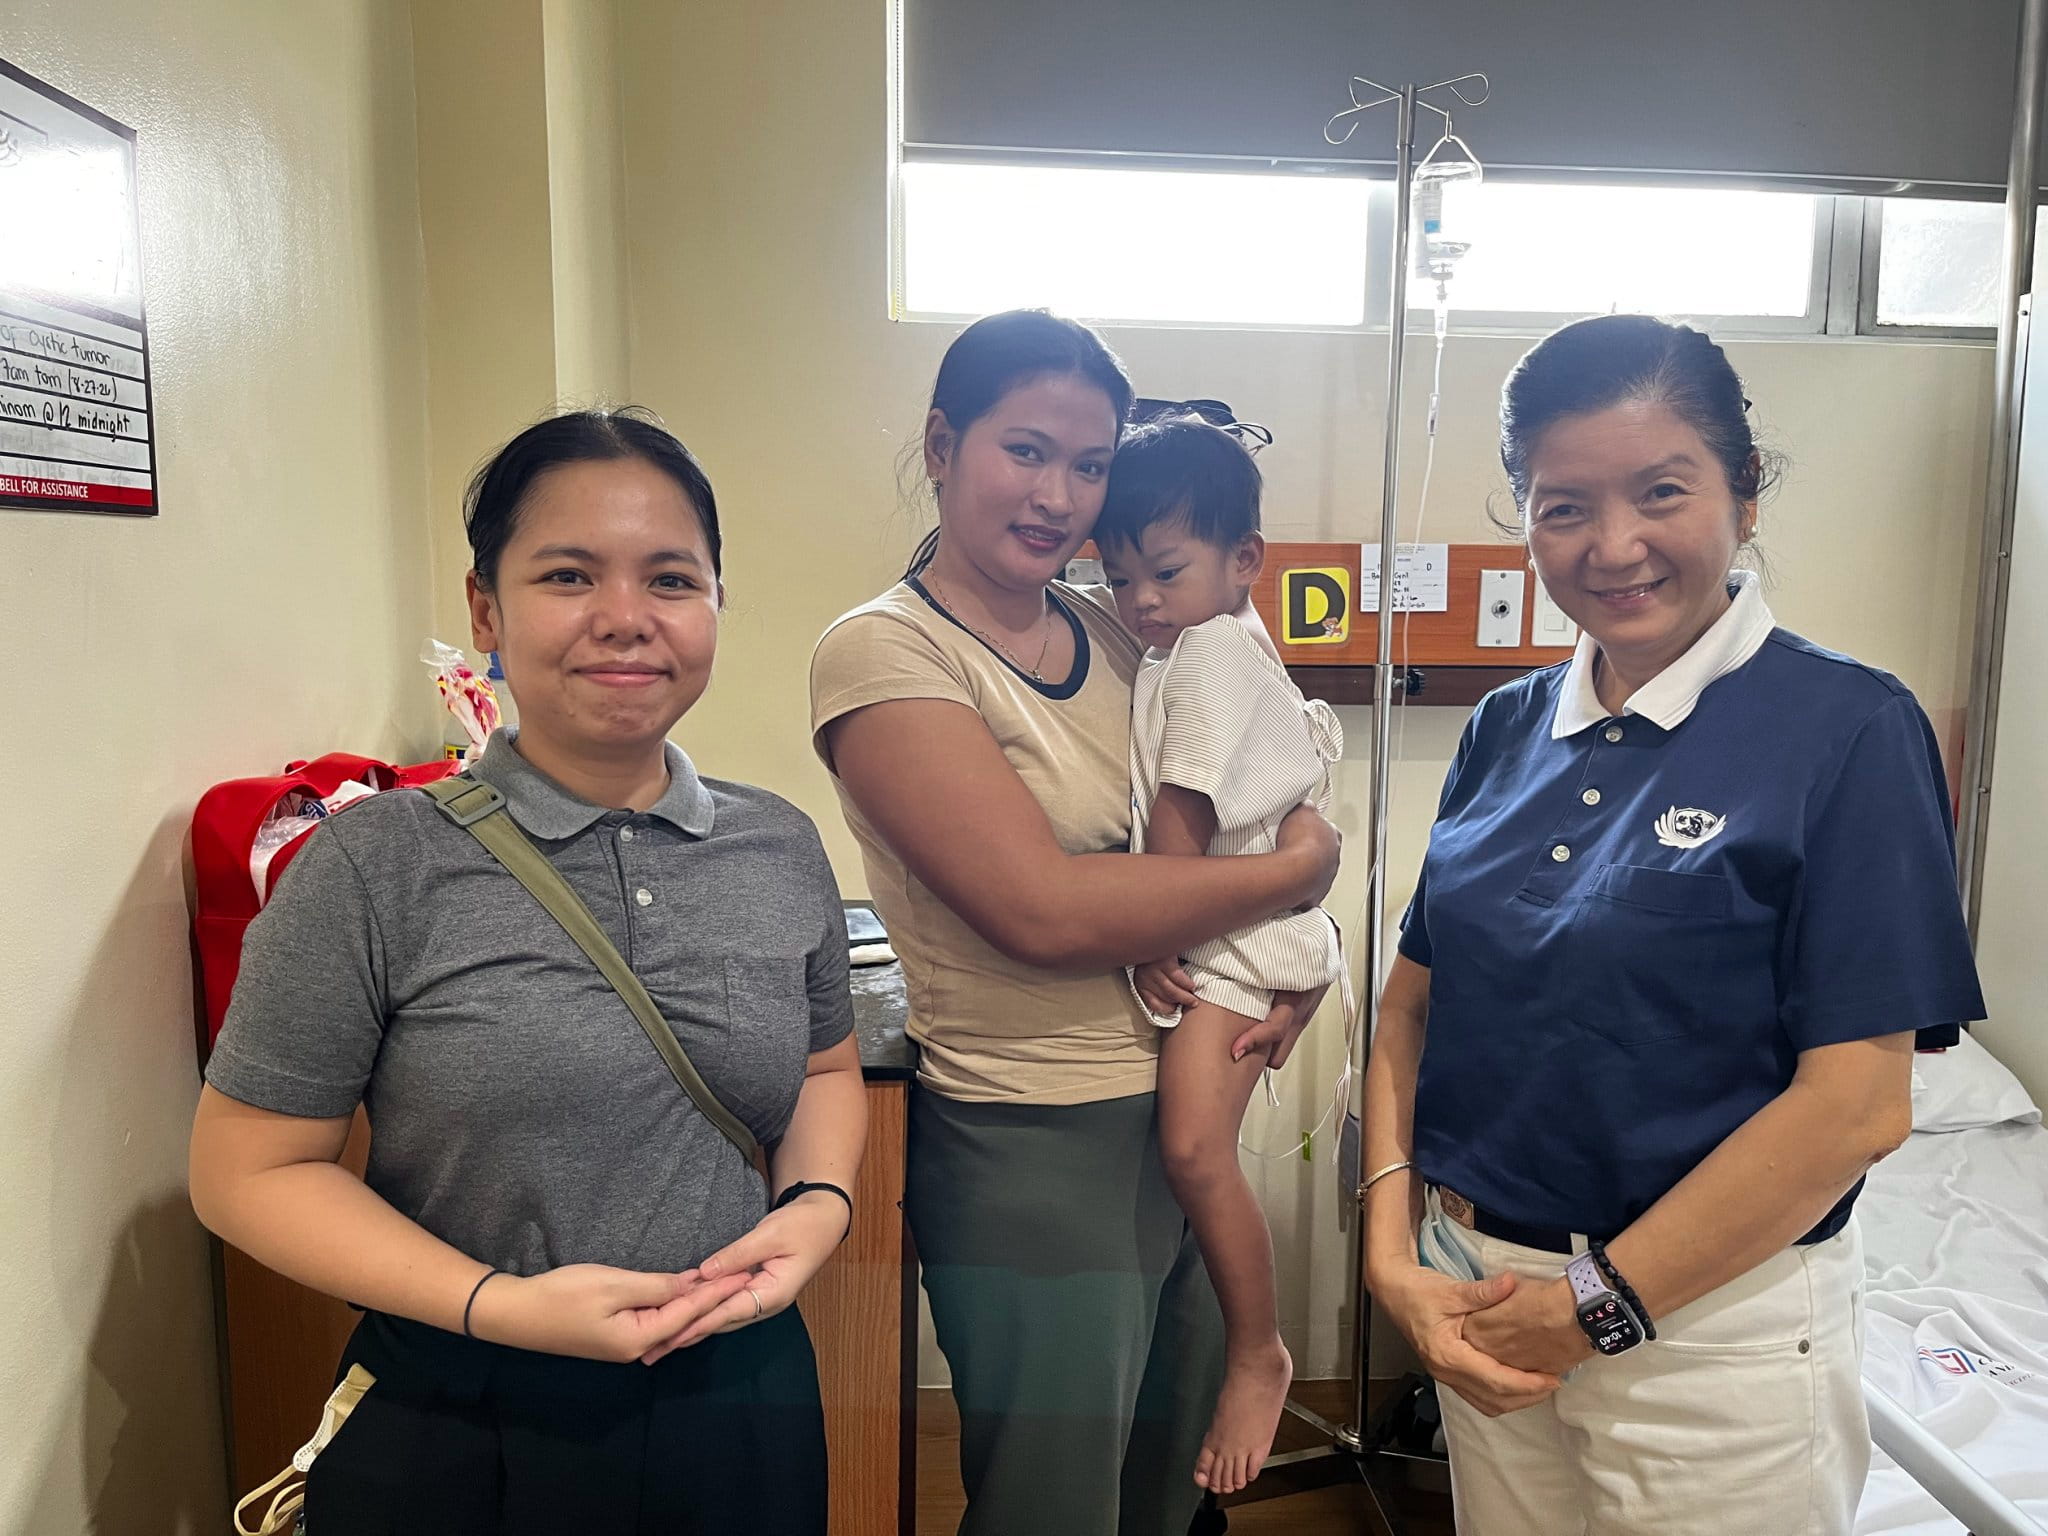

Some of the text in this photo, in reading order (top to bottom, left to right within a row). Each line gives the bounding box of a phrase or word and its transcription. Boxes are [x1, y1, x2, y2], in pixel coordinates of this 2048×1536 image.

[71, 337, 111, 366] tumor
[0, 357, 30, 382] 7am
[34, 364, 62, 389] tom
[43, 401, 54, 431] @
[59, 401, 72, 429] 12
[78, 411, 131, 443] midnight
[0, 477, 89, 499] BELL FOR ASSISTANCE
[1289, 572, 1346, 639] D
[1599, 1331, 1623, 1346] 10:40
